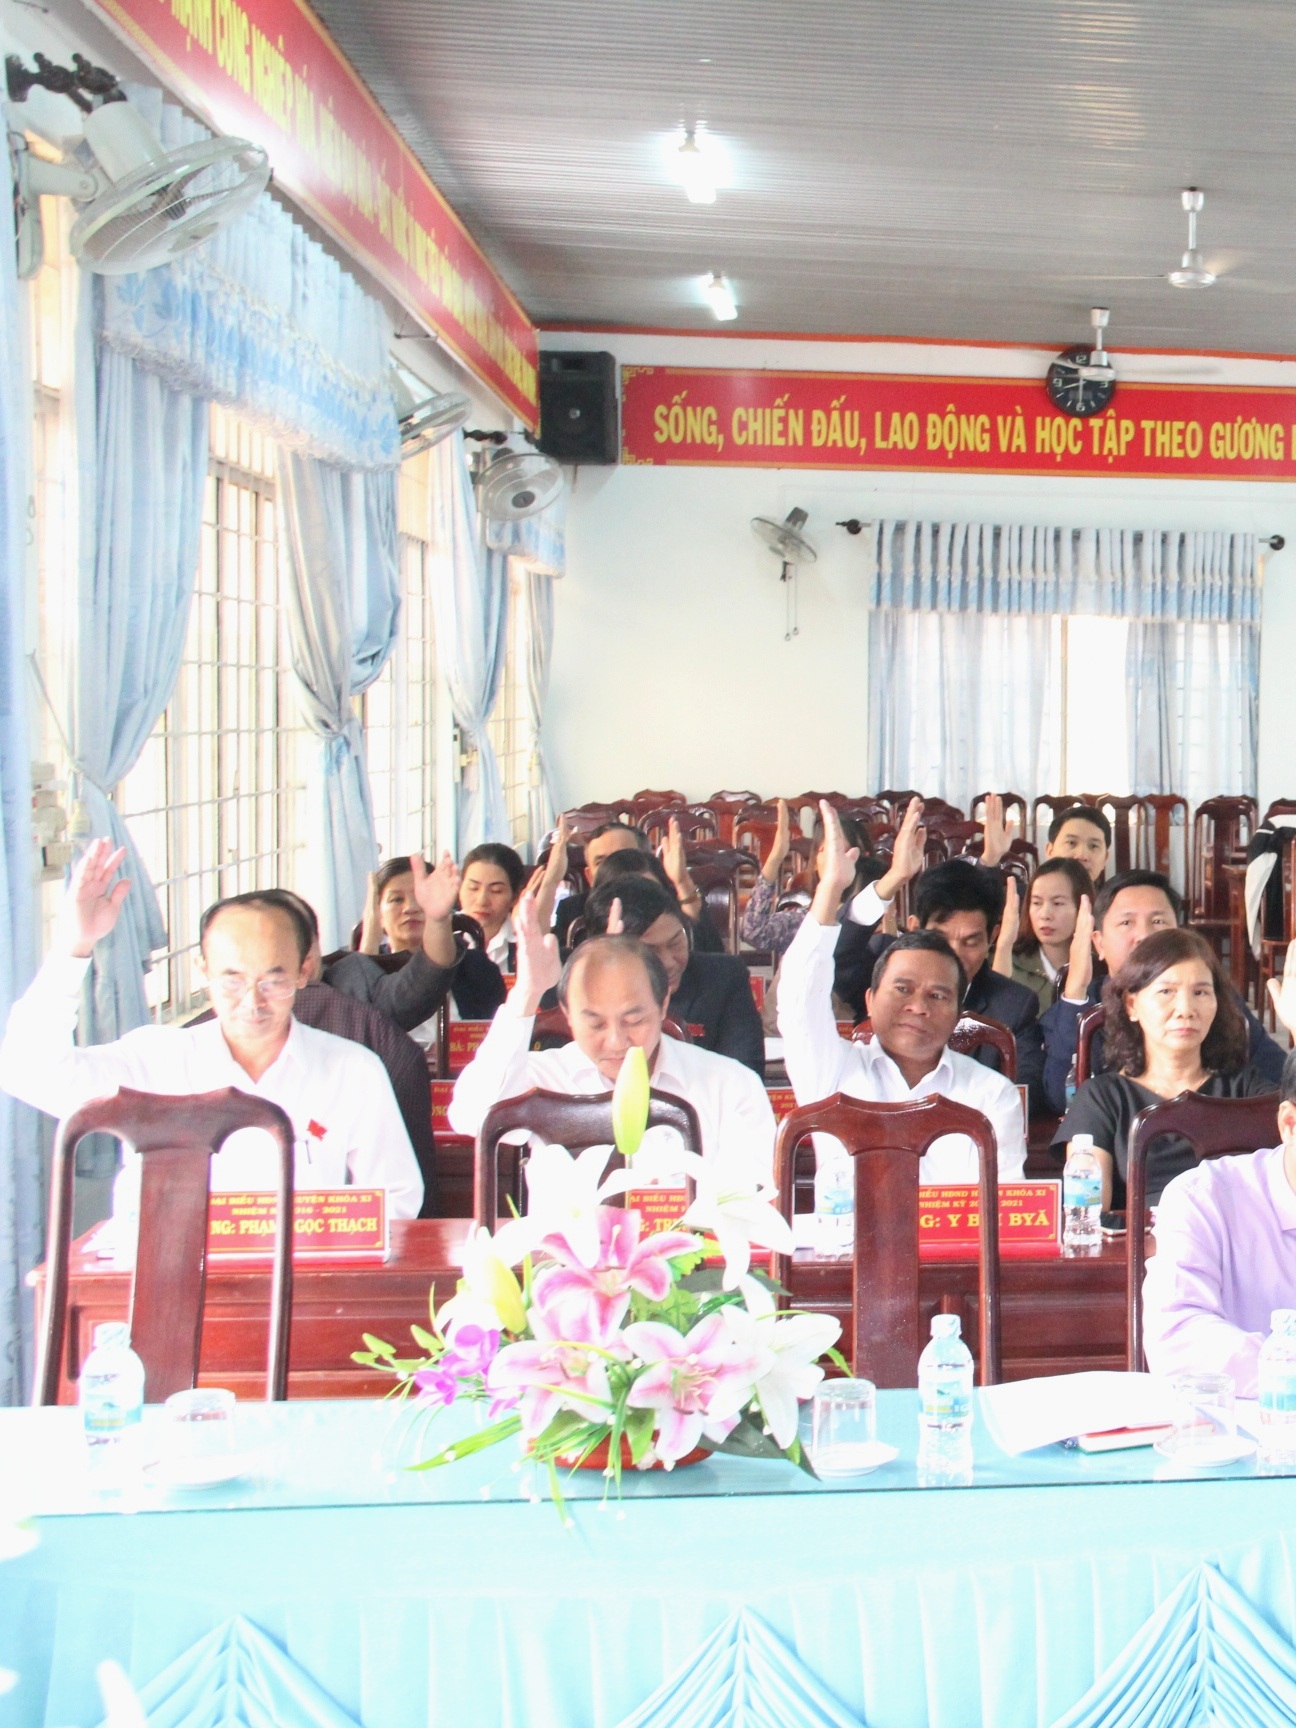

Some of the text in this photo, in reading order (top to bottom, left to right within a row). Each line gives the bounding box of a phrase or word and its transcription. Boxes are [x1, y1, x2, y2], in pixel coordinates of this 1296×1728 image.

[654, 391, 724, 452] SỐNG,
[732, 394, 803, 447] CHIẾN
[811, 395, 866, 455] ĐẤU,
[875, 411, 920, 449] LAO
[926, 403, 990, 459] ĐỘNG
[998, 405, 1027, 453] VÀ
[1035, 417, 1083, 461] HỌC
[1089, 409, 1134, 463] TẬP
[1141, 419, 1203, 459] THEO
[1209, 414, 1285, 462] GƯƠNG
[211, 1219, 236, 1235] NG:
[294, 1216, 377, 1237] GỌC THẠCH
[947, 1213, 962, 1227] Y
